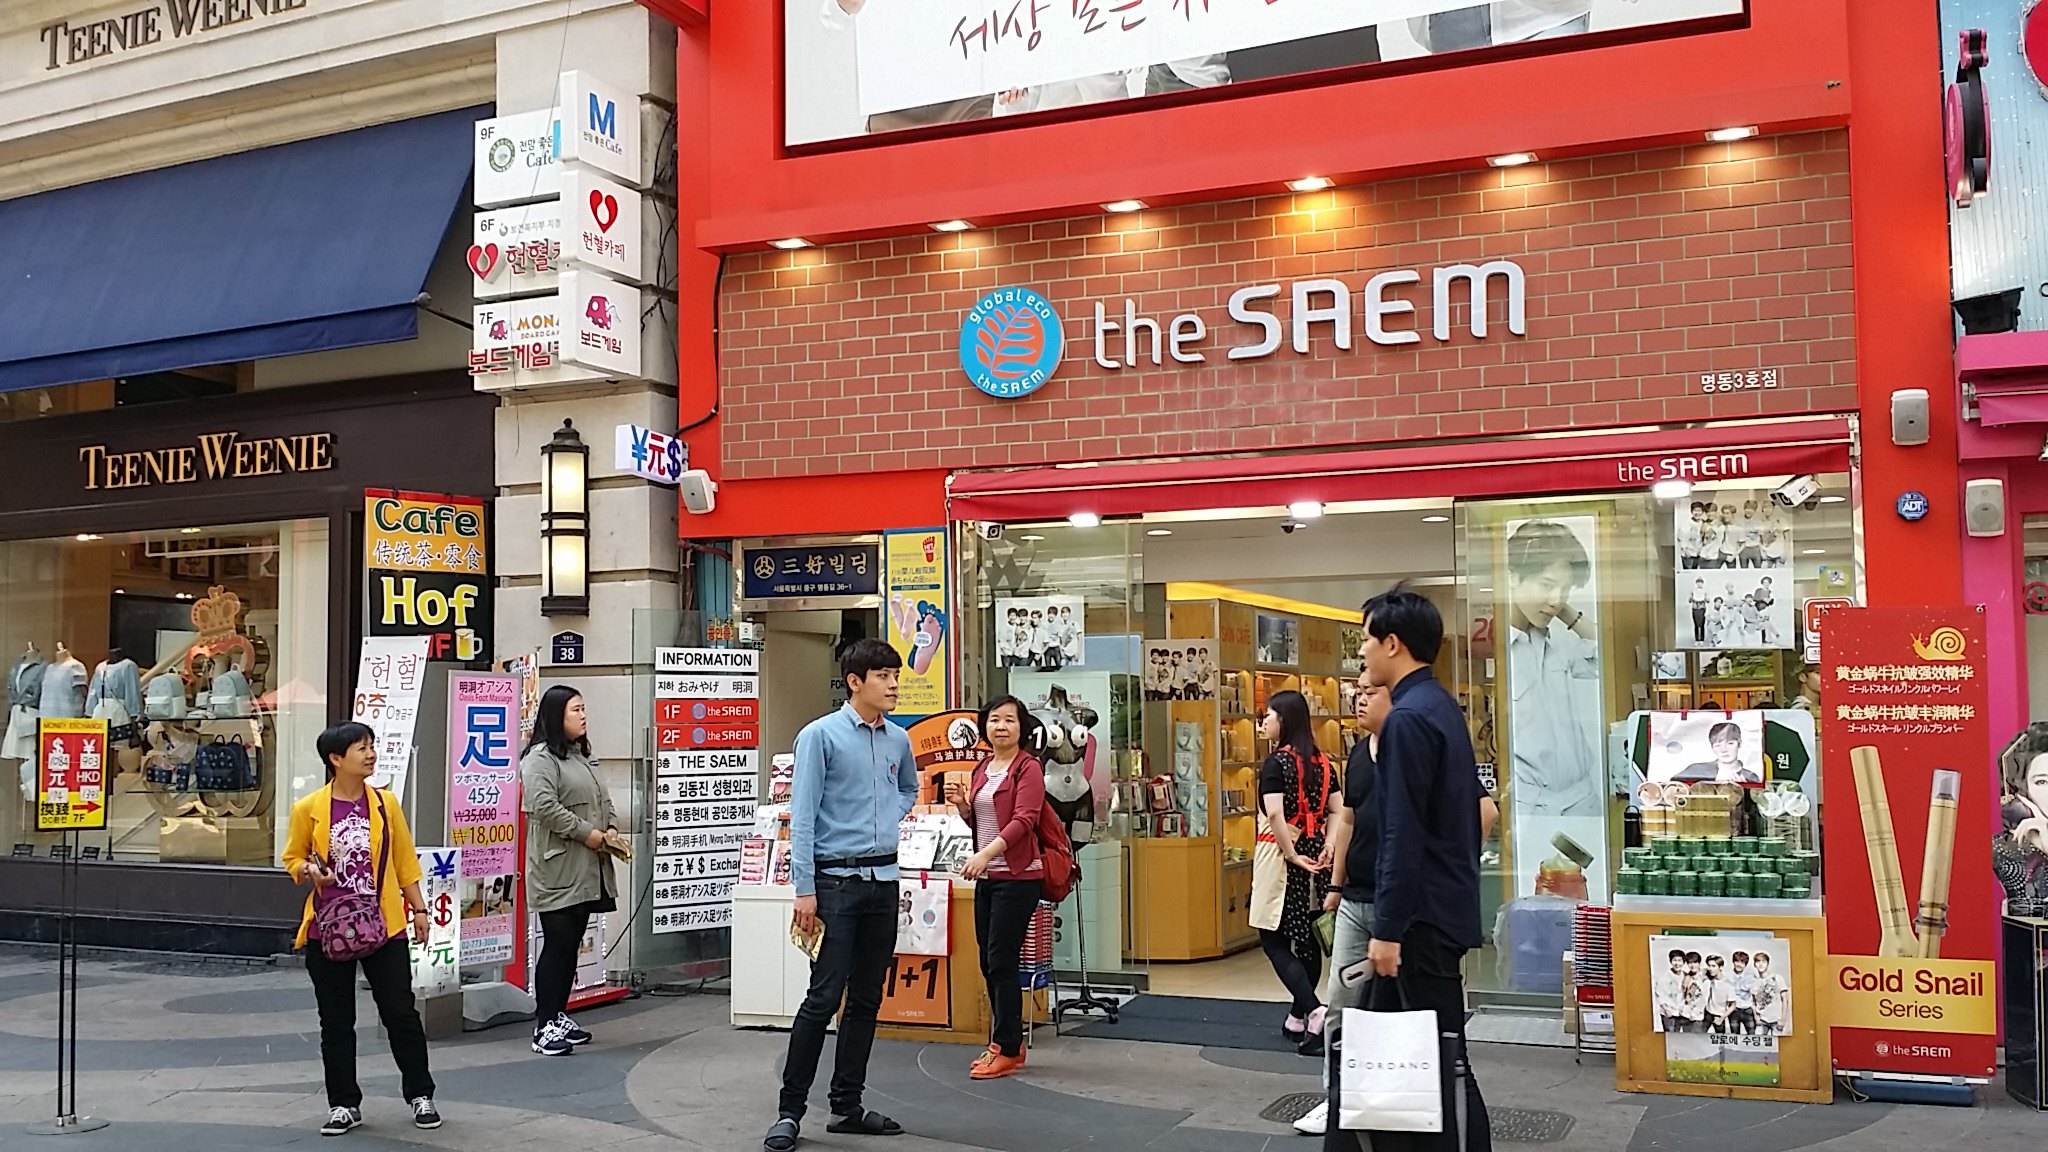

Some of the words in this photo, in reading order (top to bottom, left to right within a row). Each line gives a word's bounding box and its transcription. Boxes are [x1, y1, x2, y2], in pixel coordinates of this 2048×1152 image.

[950, 0, 1051, 59] 세상
[40, 7, 161, 70] TEENIE
[589, 93, 615, 139] M
[480, 126, 495, 140] 9F
[520, 139, 535, 152] 전망
[526, 150, 554, 168] Cafe
[480, 219, 495, 232] 6F
[583, 231, 625, 262] 헌혈카페
[969, 288, 1021, 324] global
[1026, 296, 1051, 319] eco
[1095, 299, 1206, 368] the
[1227, 260, 1526, 360] SAEM
[480, 312, 494, 325] 7F
[581, 330, 622, 354] 보드게임
[1701, 368, 1778, 392] 명동3호점
[79, 445, 197, 490] TEENIE
[197, 432, 332, 480] WEENIE
[1618, 462, 1654, 482] the
[1659, 453, 1749, 480] SAEM
[1902, 501, 1923, 511] ADT
[374, 498, 480, 537] Cafe
[375, 540, 483, 570] 传统茶·零食
[782, 553, 867, 576] 三好빌딩
[380, 576, 479, 627] Hof
[560, 648, 575, 660] 38
[662, 652, 751, 666] INFORMATION
[1836, 664, 1974, 681] 黄金蜗牛抗皱强效精华
[459, 681, 513, 693] 明洞オアシス
[657, 682, 674, 691] 지하
[678, 681, 720, 693] おみやげ
[732, 681, 753, 693] 明洞
[355, 693, 387, 719] 6층
[663, 705, 680, 719] 1F
[1836, 704, 1976, 721] 黄金蜗牛抗皱丰润精华
[460, 706, 511, 767] 足
[663, 730, 680, 744] 2F
[52, 737, 64, 754] $
[83, 738, 96, 754] ¥
[657, 758, 670, 768] 3층
[679, 756, 705, 769] THE
[709, 755, 747, 768] SAEM
[1776, 753, 1789, 769] 원
[76, 771, 100, 783] HKD
[455, 773, 514, 784] ツボマッサージ
[468, 786, 500, 805] 45分
[678, 781, 709, 797] 김동진
[712, 779, 752, 796] 성형외과
[73, 814, 86, 823] 7F
[674, 807, 709, 822] 명동현대
[712, 805, 754, 820] 공인중개사
[453, 824, 514, 845] ₩18,000
[672, 835, 707, 848] 明洞手机
[432, 851, 456, 879] ¥
[656, 863, 669, 872] 7층
[655, 889, 669, 898] 8층
[434, 893, 452, 928] $
[655, 915, 669, 925] 9층
[431, 941, 455, 967] 元
[1839, 966, 1903, 993] Gold
[1914, 969, 1983, 996] Snail
[1879, 998, 1943, 1019] Series
[1742, 1036, 1760, 1046] 수딩
[1893, 1046, 1910, 1056] the
[1911, 1046, 1951, 1058] SAEM
